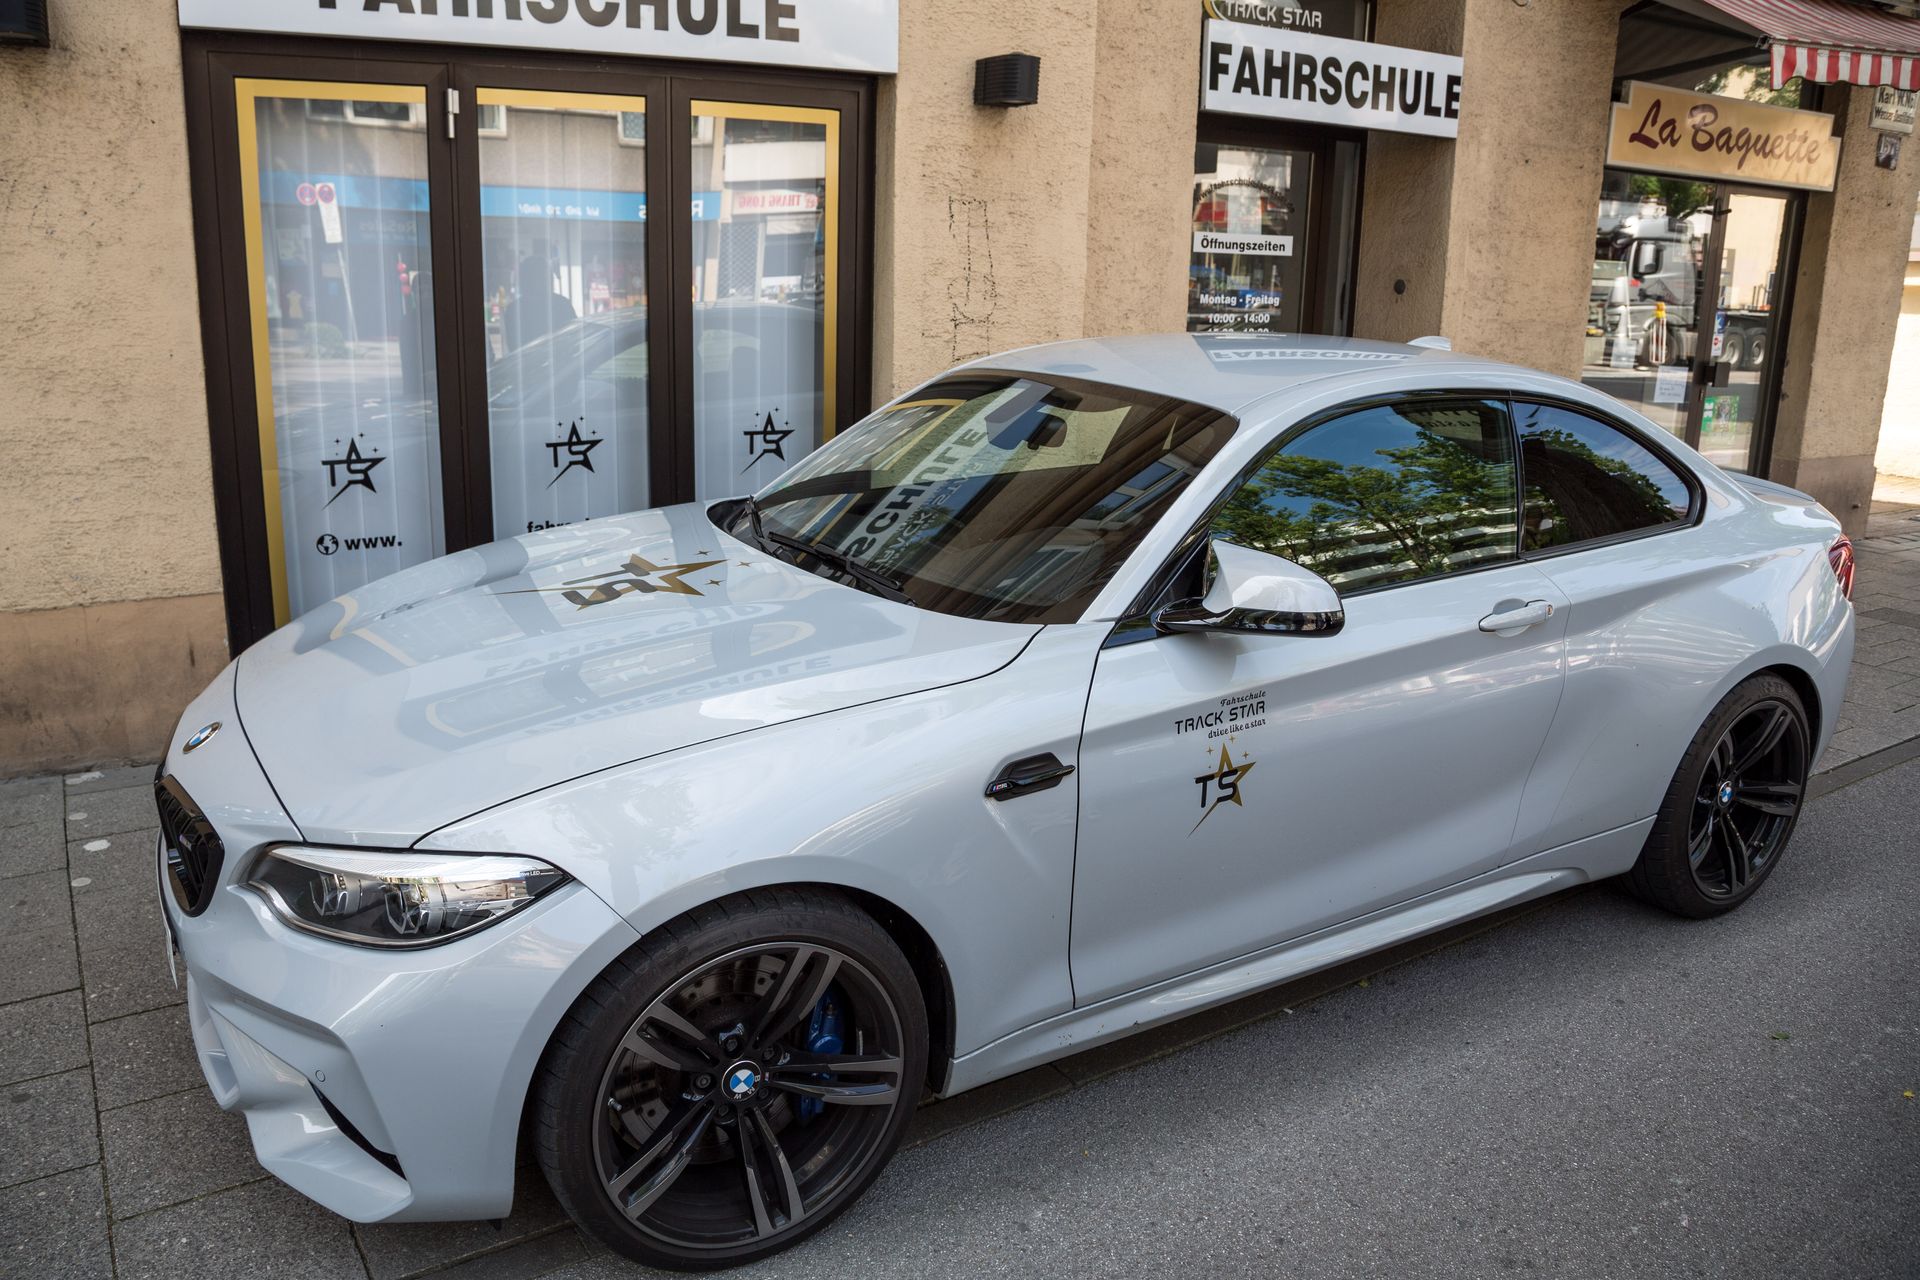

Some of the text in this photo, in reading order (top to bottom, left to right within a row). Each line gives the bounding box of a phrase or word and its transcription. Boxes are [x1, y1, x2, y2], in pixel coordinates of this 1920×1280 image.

[319, 0, 799, 43] CHULE
[1225, 0, 1277, 23] TRACK
[1282, 7, 1322, 29] STAR
[1208, 41, 1463, 119] FAHRSCHULE
[1629, 98, 1821, 171] La Baguette
[1200, 234, 1286, 253] Öffnungszeiten
[1200, 293, 1237, 306] Montag
[1245, 294, 1280, 307] Freitag
[1208, 313, 1235, 324] 10:00
[1243, 313, 1271, 324] 14:00
[344, 534, 403, 551] www.
[1220, 690, 1267, 708] Fahrschule
[1174, 700, 1266, 735] TRACK STAR
[1207, 717, 1267, 739] drive like a star
